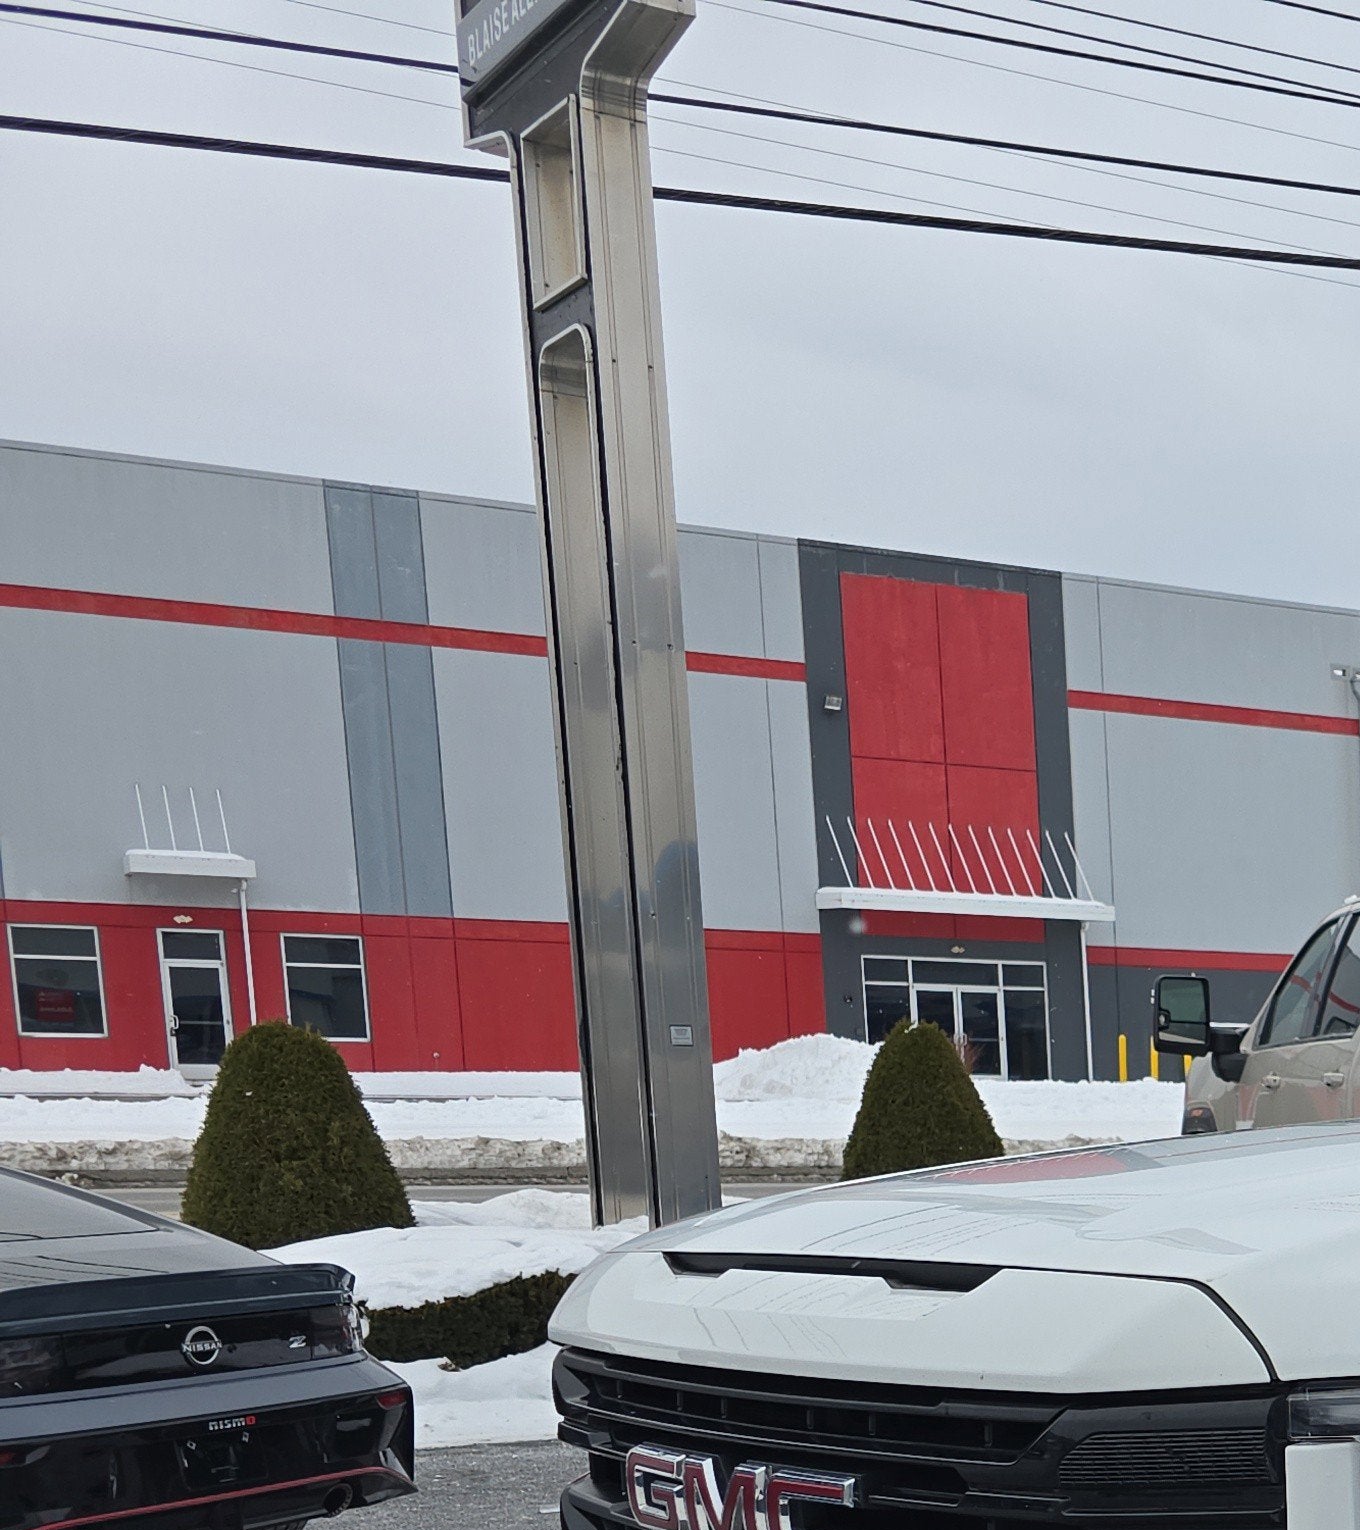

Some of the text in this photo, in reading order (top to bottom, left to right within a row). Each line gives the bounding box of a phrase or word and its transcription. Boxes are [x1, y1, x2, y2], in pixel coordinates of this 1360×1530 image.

[467, 0, 510, 67] BLAISE
[181, 1339, 223, 1354] NISSAN
[288, 1335, 307, 1349] Z
